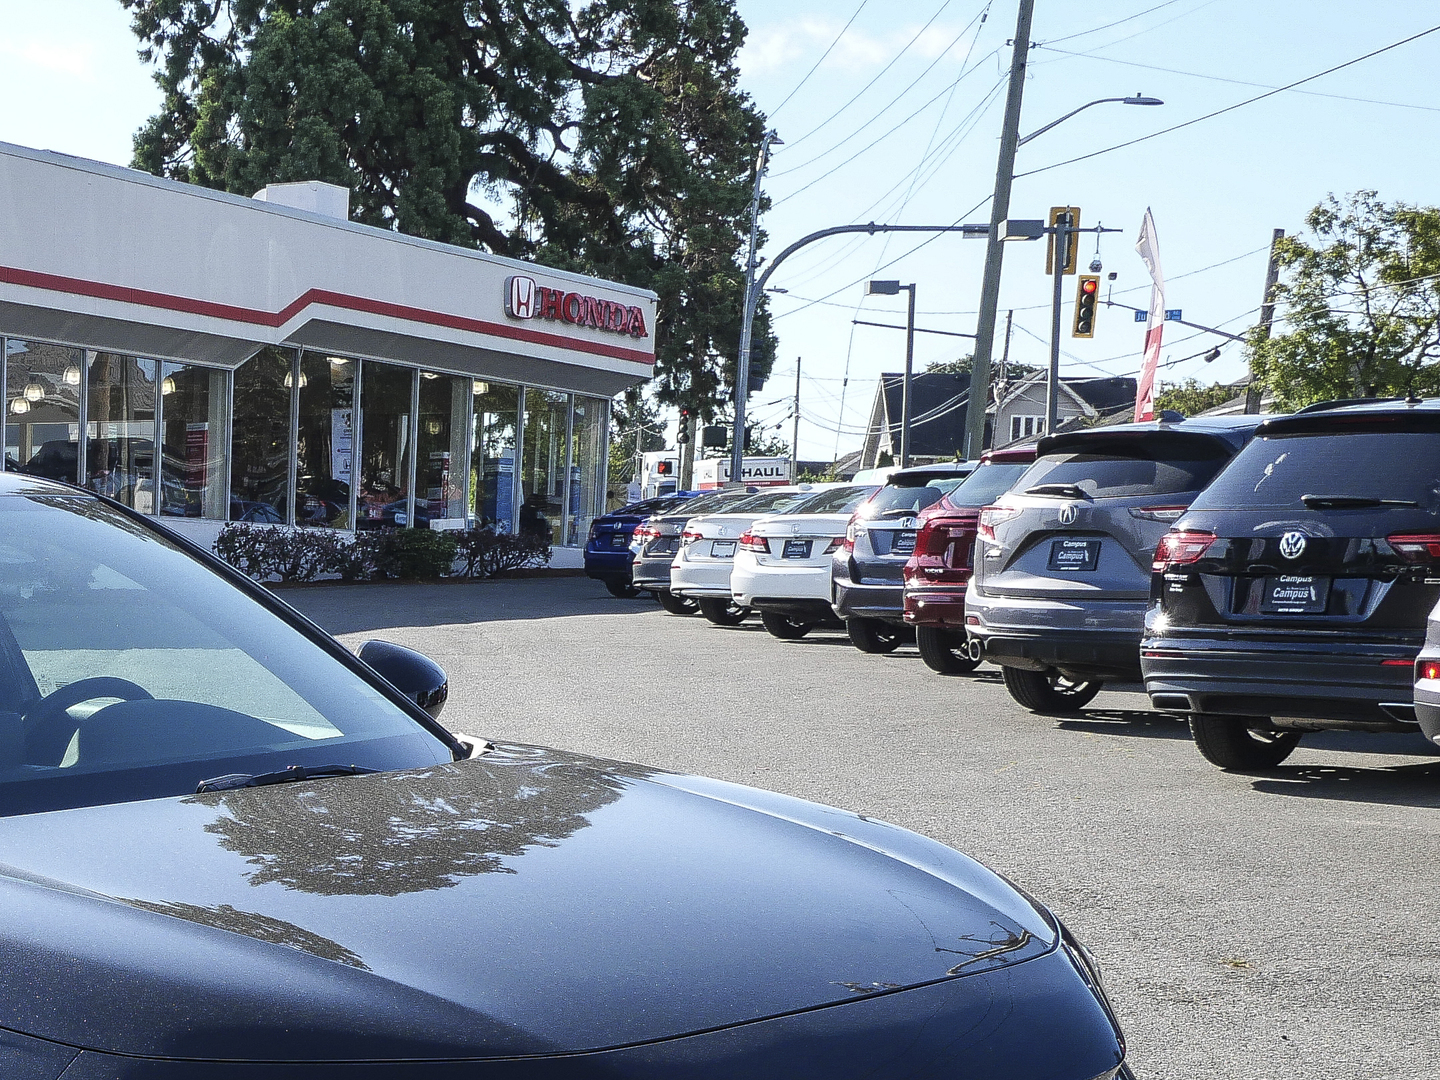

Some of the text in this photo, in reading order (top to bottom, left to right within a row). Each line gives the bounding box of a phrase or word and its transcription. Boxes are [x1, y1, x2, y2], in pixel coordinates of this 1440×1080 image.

[539, 286, 649, 338] HONDA
[724, 467, 784, 478] UHAUL
[1280, 574, 1313, 584] Campus
[1273, 587, 1309, 600] Campus
